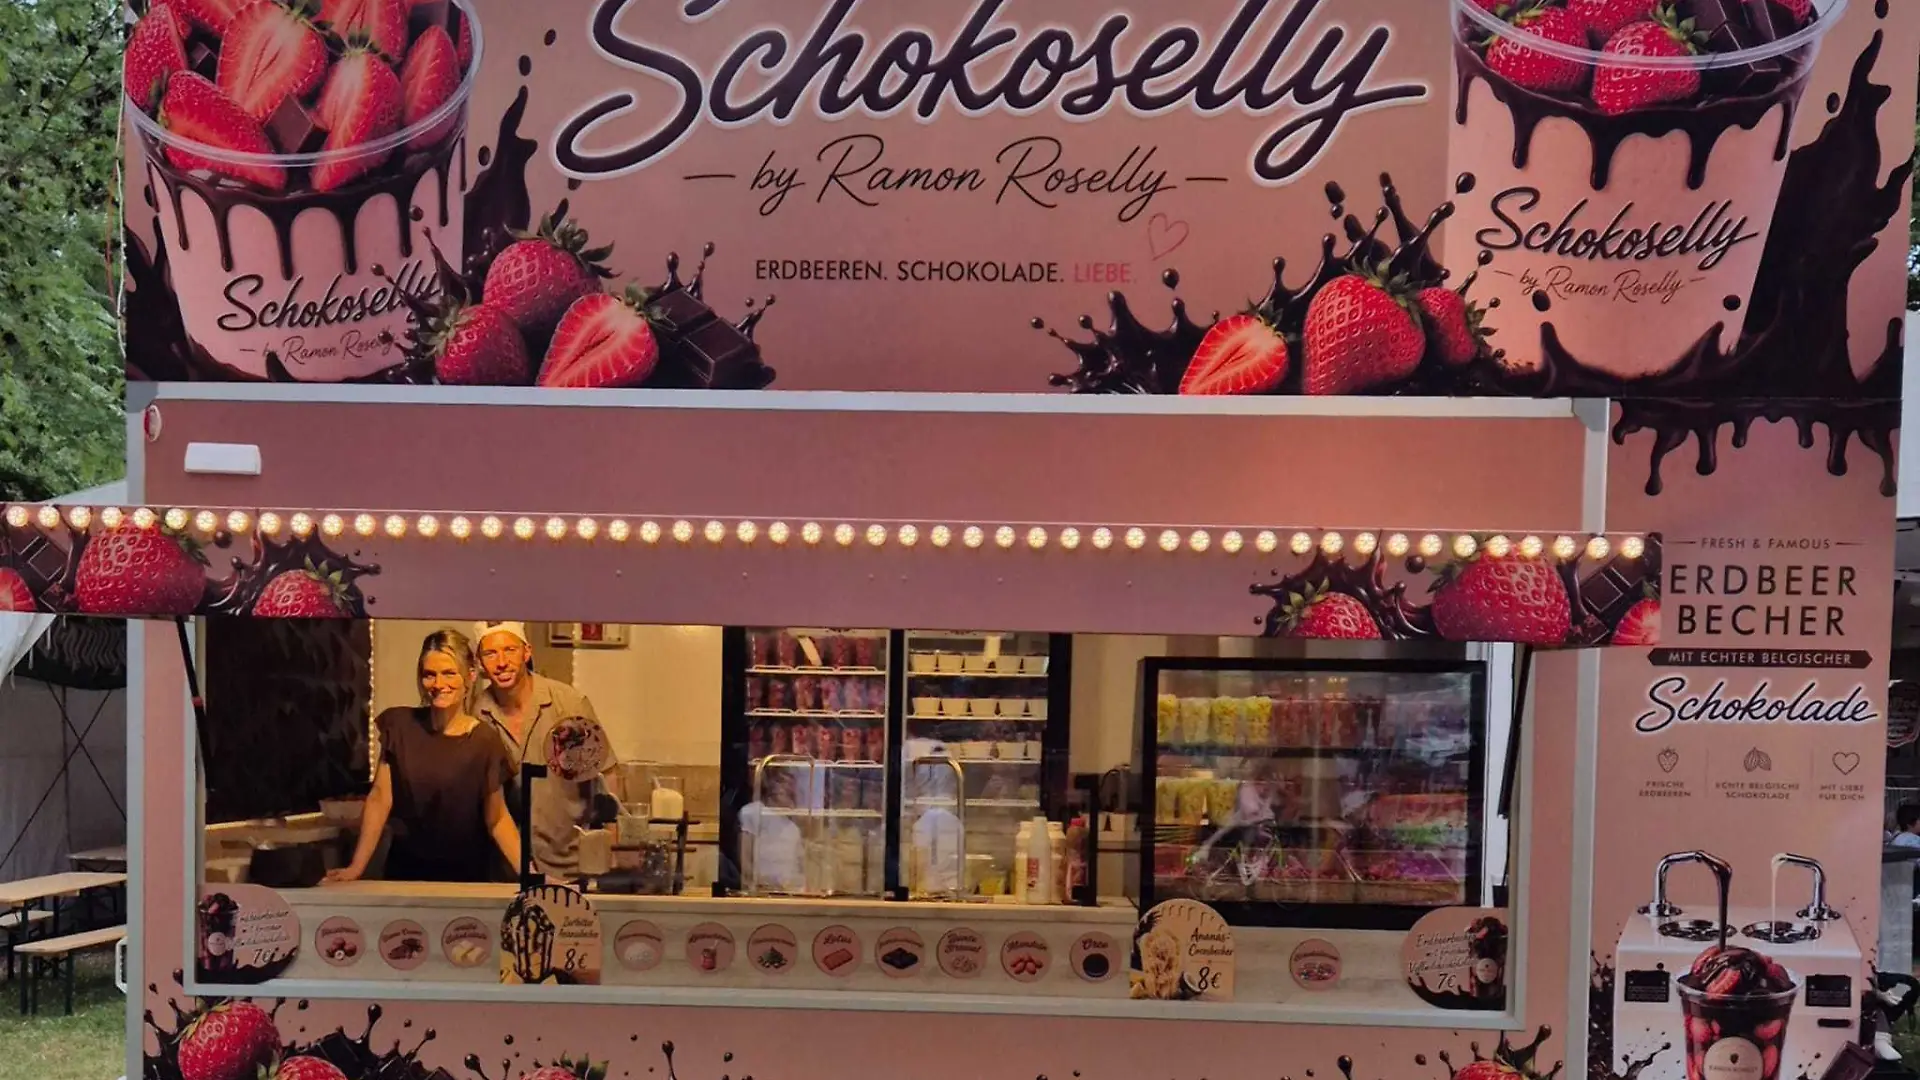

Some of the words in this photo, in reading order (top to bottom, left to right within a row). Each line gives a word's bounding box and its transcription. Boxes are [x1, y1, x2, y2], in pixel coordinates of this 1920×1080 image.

[552, 0, 1428, 180] Schokoselly
[750, 150, 805, 216] by
[816, 133, 985, 207] Ramon
[995, 136, 1178, 222] Roselly
[1475, 186, 1759, 271] Schokoselly
[755, 259, 889, 282] ERDBEEREN.
[897, 260, 1064, 284] SCHOKOLADE.
[1073, 264, 1138, 284] LIEBE.
[1519, 268, 1541, 294] by
[1545, 265, 1610, 300] Ramon
[1613, 269, 1685, 304] Roselly
[282, 335, 340, 365] Ramon
[1701, 538, 1745, 549] FRESH
[1752, 539, 1761, 549] &
[1768, 539, 1831, 550] FAMOUS
[1670, 564, 1857, 596] ERDBEER
[1678, 604, 1846, 636] BECHER
[1668, 652, 1693, 663] MIT
[1700, 652, 1755, 663] ECHTER
[1762, 653, 1852, 665] BELGISCHER
[1635, 676, 1879, 733] Schokolade
[823, 933, 853, 945] Lotus
